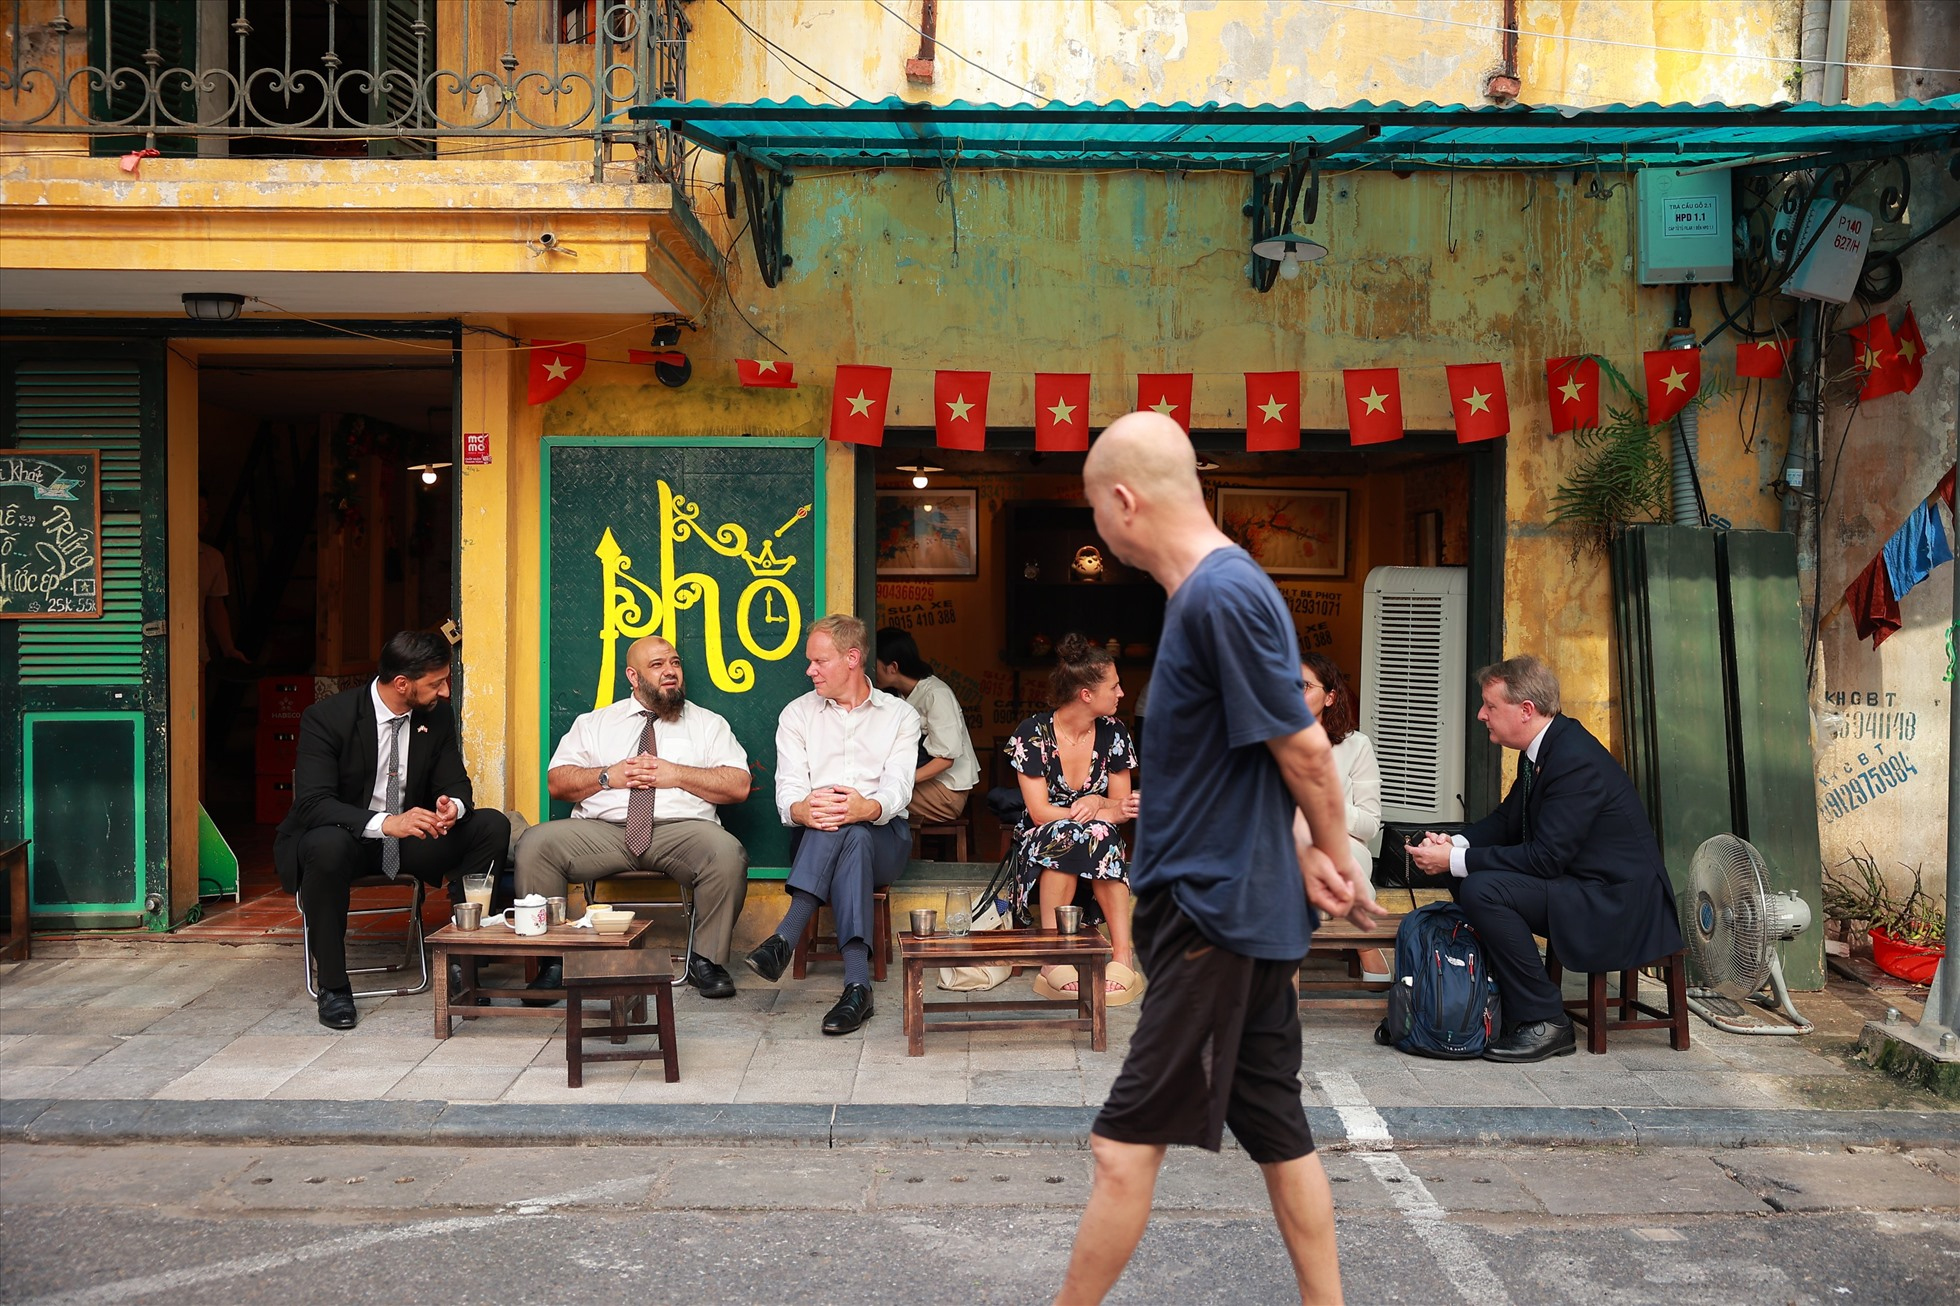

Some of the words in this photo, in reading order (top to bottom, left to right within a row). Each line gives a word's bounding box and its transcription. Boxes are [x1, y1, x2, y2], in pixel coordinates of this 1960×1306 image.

[1676, 213, 1692, 222] HPD
[1694, 213, 1705, 221] 1.1
[1315, 592, 1342, 600] PHOT
[888, 604, 924, 615] SUA
[931, 600, 952, 609] XE
[889, 614, 913, 630] 0915
[916, 612, 935, 627] 410
[938, 609, 956, 624] 388
[1313, 631, 1333, 648] 388
